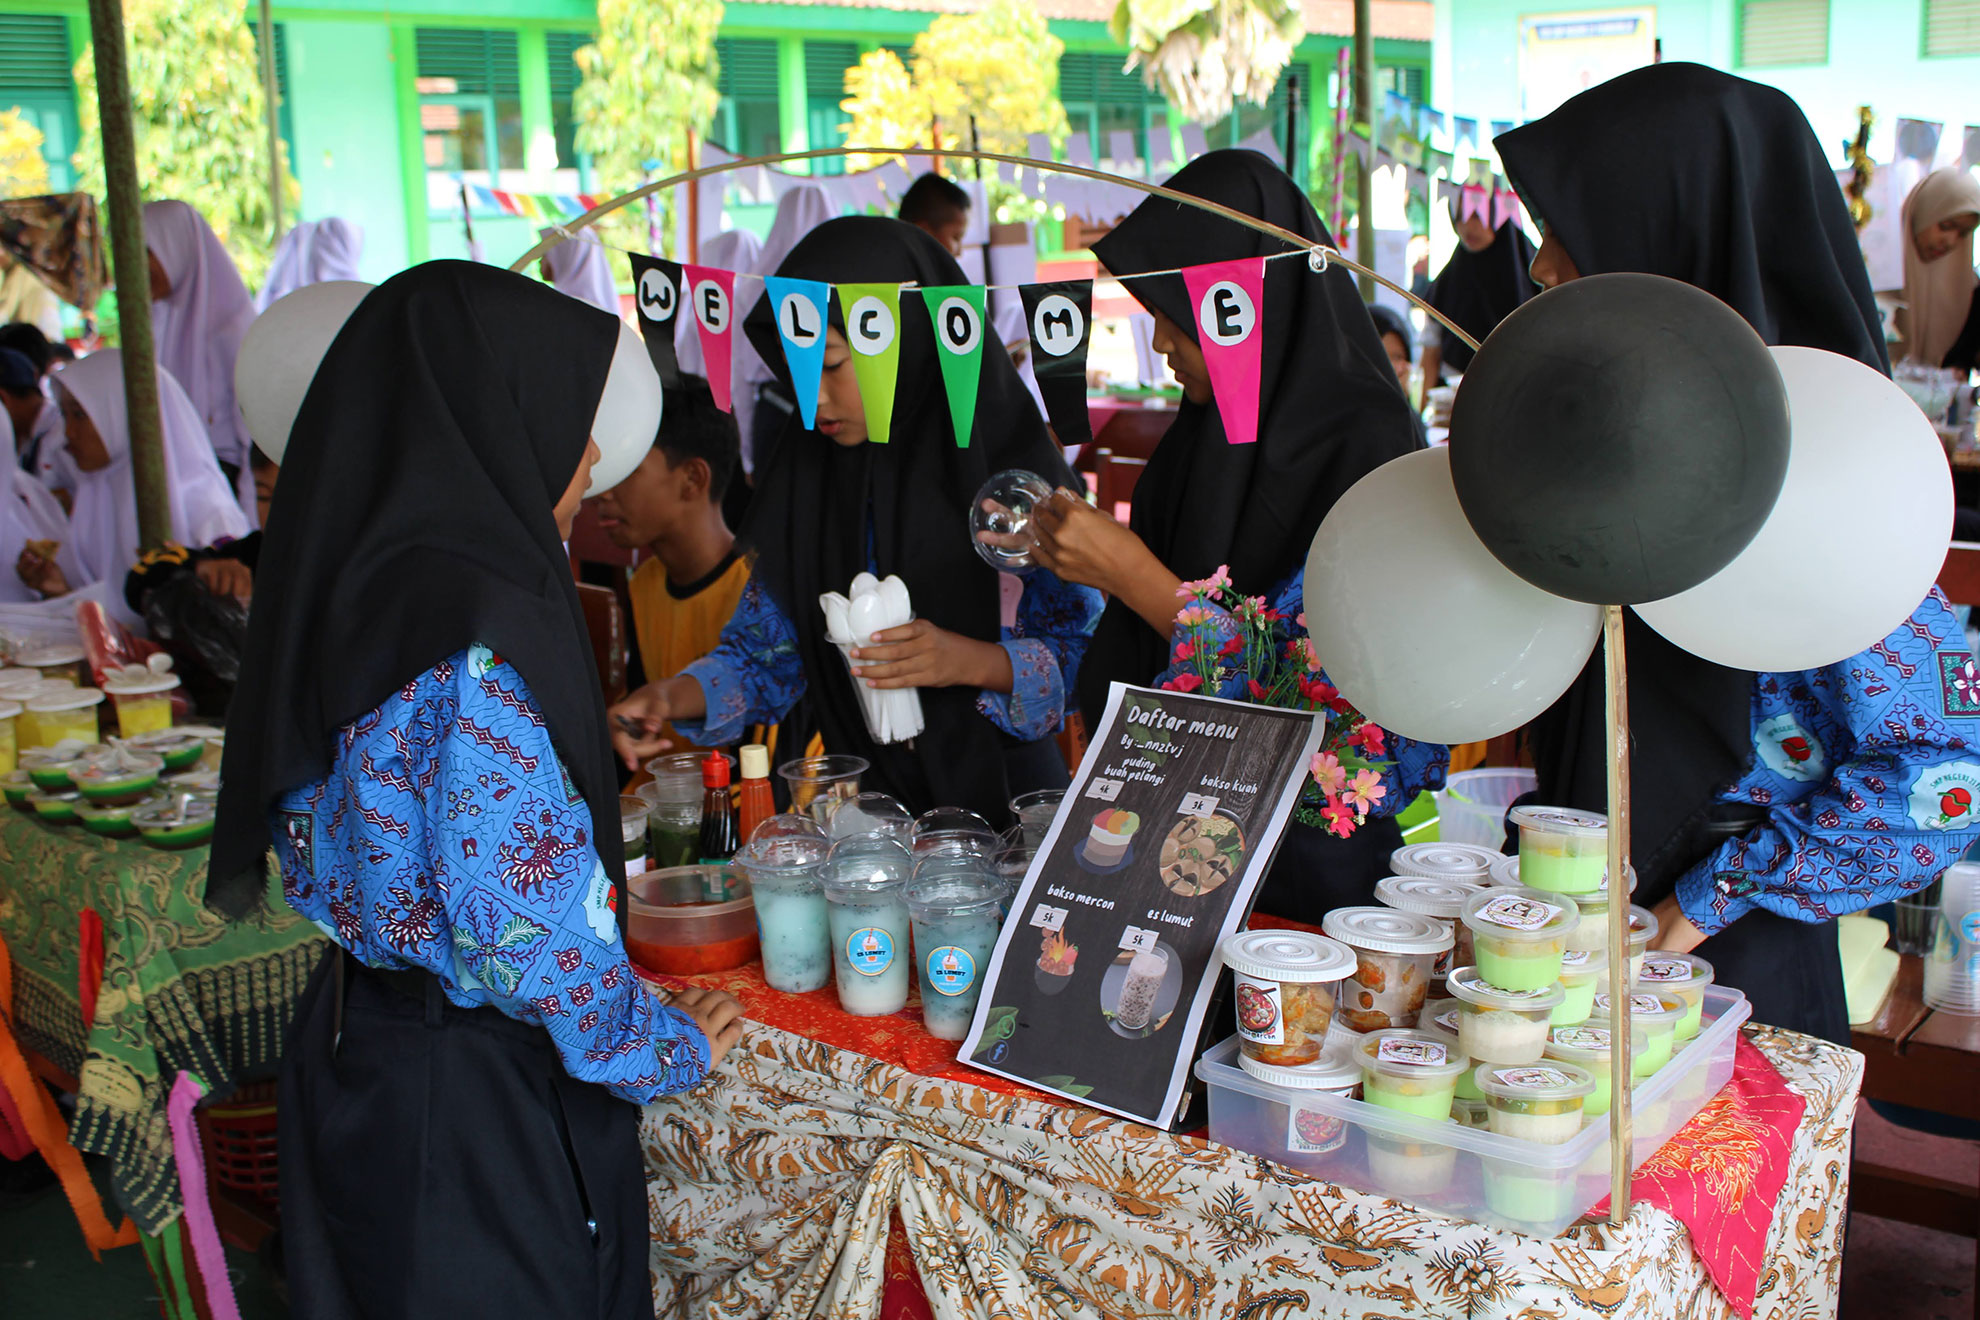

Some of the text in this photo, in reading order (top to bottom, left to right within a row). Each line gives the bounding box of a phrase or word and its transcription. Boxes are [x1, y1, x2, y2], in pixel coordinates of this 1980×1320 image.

[1126, 705, 1240, 741] Daftar menu
[1121, 756, 1156, 772] puding
[1104, 764, 1166, 786] buah pelangi
[1099, 784, 1110, 794] 4k
[1200, 774, 1258, 795] bakso kuah
[1191, 800, 1203, 811] 3k
[1047, 884, 1115, 911] bakso mercon
[1042, 911, 1055, 923] 5k
[1147, 909, 1195, 928] es lumut
[1132, 934, 1144, 946] 5k
